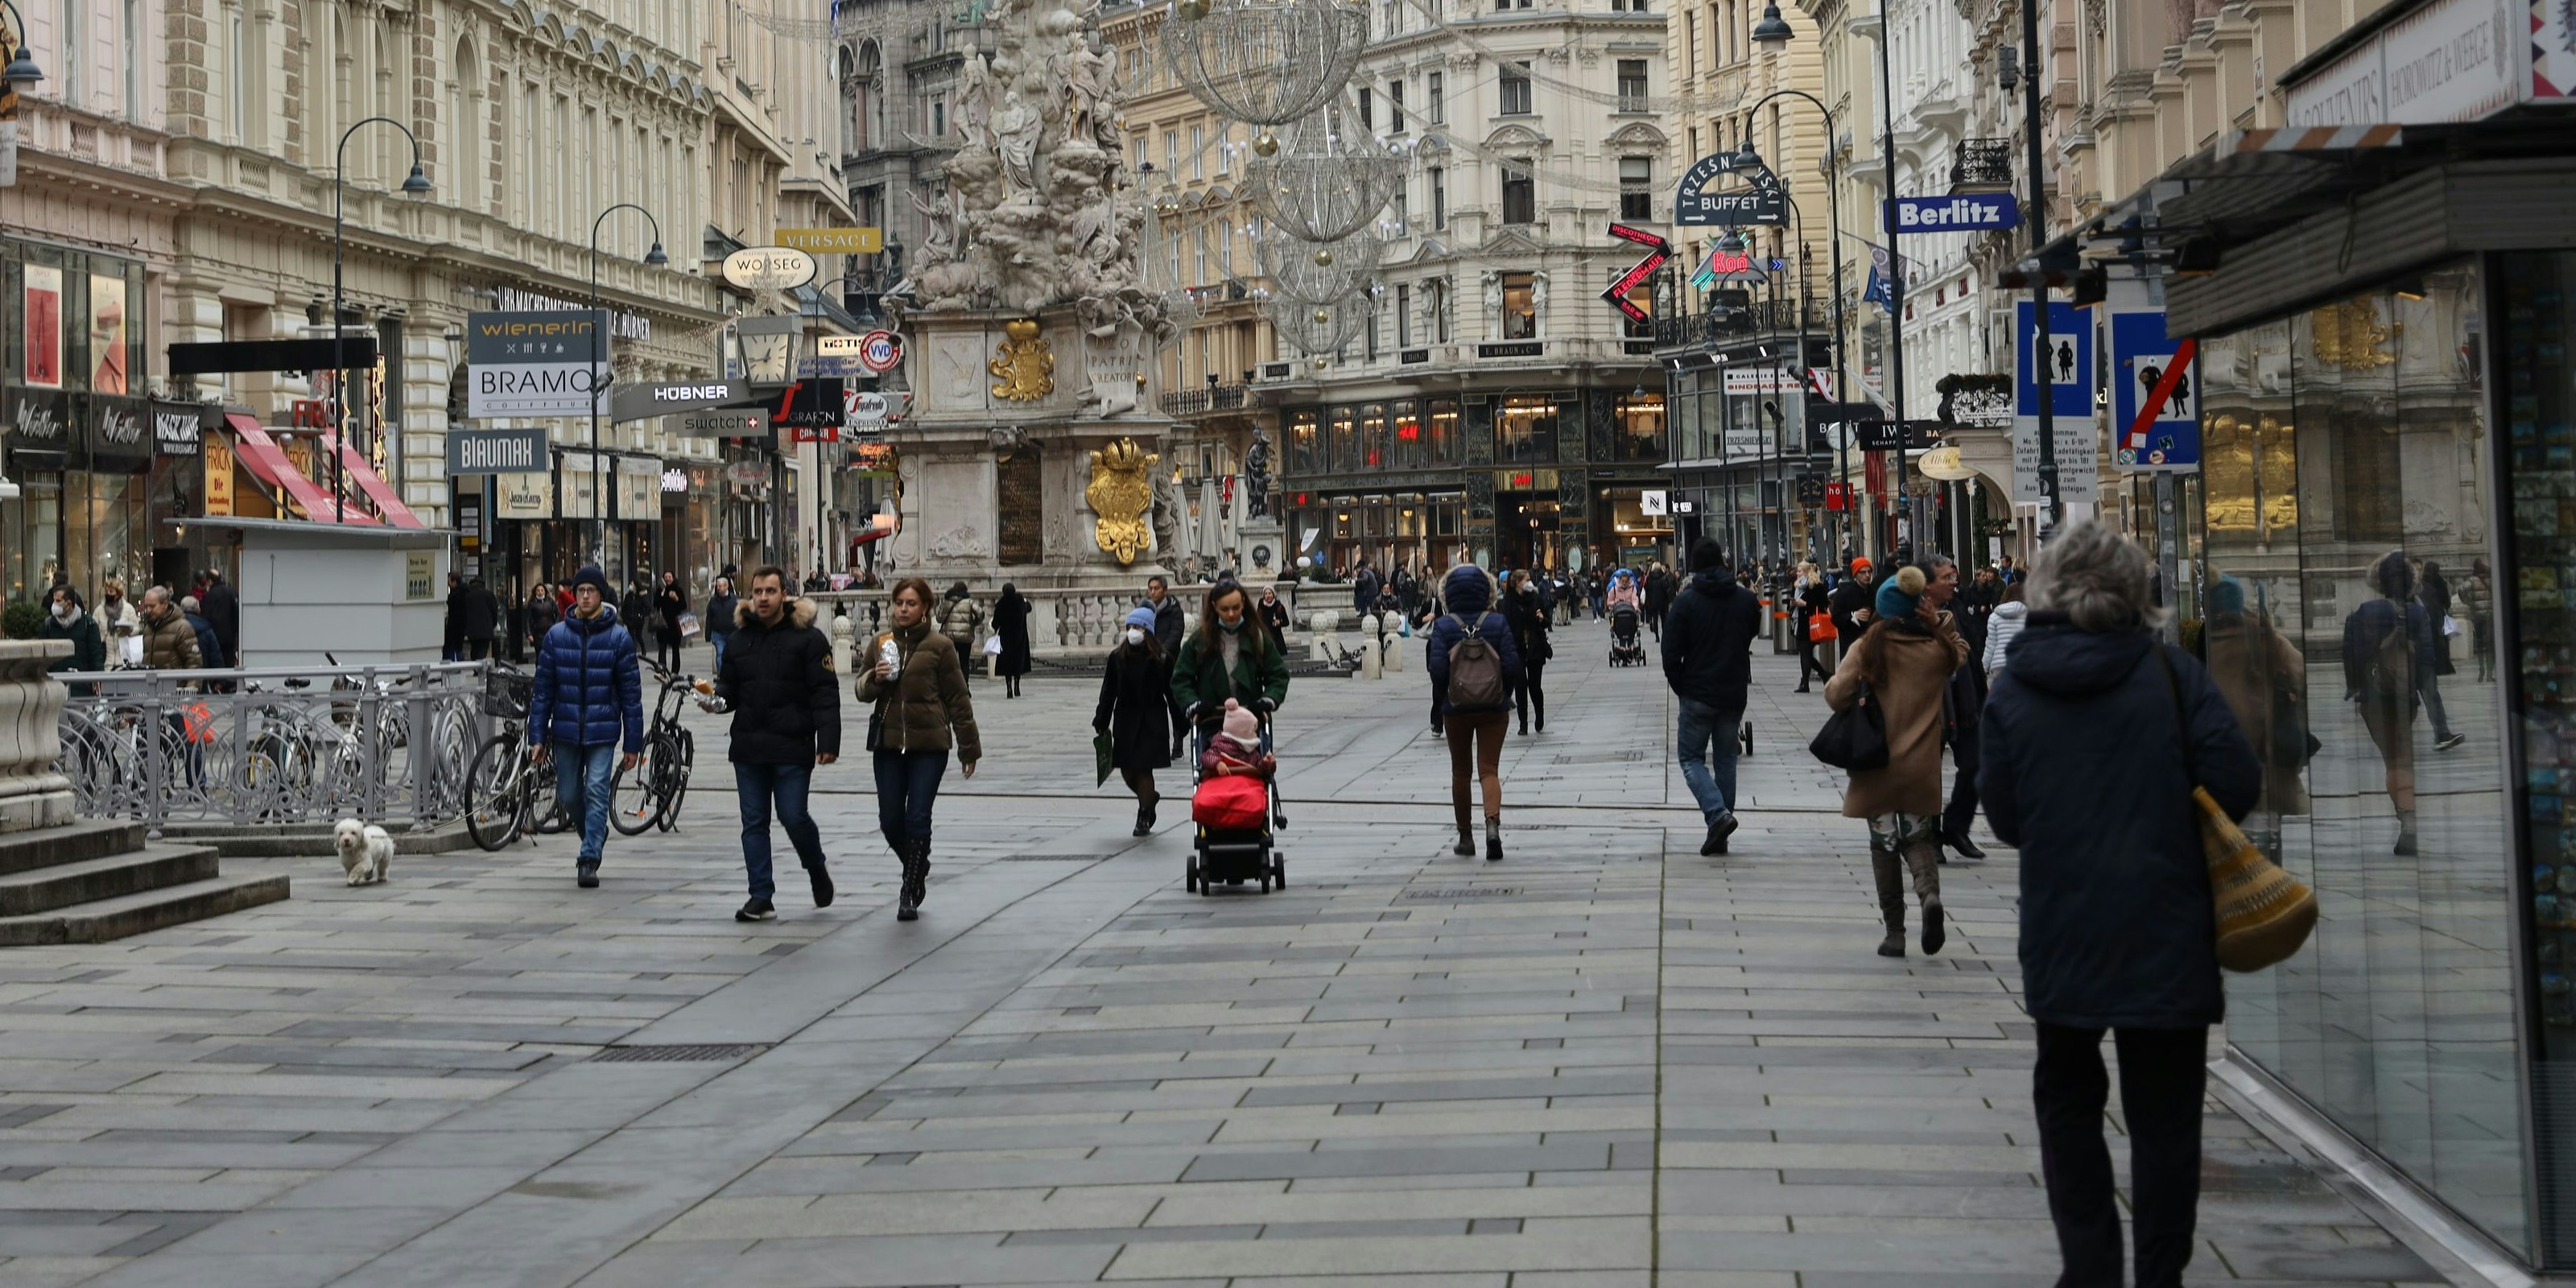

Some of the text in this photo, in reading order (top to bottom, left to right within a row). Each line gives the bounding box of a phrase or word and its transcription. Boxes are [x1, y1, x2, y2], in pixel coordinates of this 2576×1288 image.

[2391, 21, 2489, 108] HOROWITZ & WEEGE
[2305, 69, 2379, 123] UVENIRS
[1682, 156, 1779, 208] TRZEŚNSKI
[1701, 196, 1760, 210] BUFFET
[1899, 199, 2000, 225] Berlitz
[787, 233, 869, 247] VERSACE
[1612, 225, 1662, 244] DISCOTHEQUE
[737, 258, 801, 270] WOSEG
[1612, 254, 1665, 299] FLEDERMAUS
[498, 286, 584, 312] UHRMACHERM
[1620, 301, 1636, 313] BAR
[621, 308, 650, 341] HÜBNER
[1096, 337, 1129, 349] DEO
[1494, 345, 1519, 355] BRAUN
[871, 345, 890, 357] VVD
[1092, 356, 1132, 367] PATRI
[654, 385, 728, 401] HÜBNER
[486, 402, 591, 410] COIFFEUR
[685, 415, 746, 430] swatch
[789, 411, 835, 422] GRAN
[1882, 424, 1912, 438] IWC
[737, 468, 765, 480] Triumph
[2059, 466, 2095, 474] amtgewicht
[2058, 485, 2087, 493] insteigen
